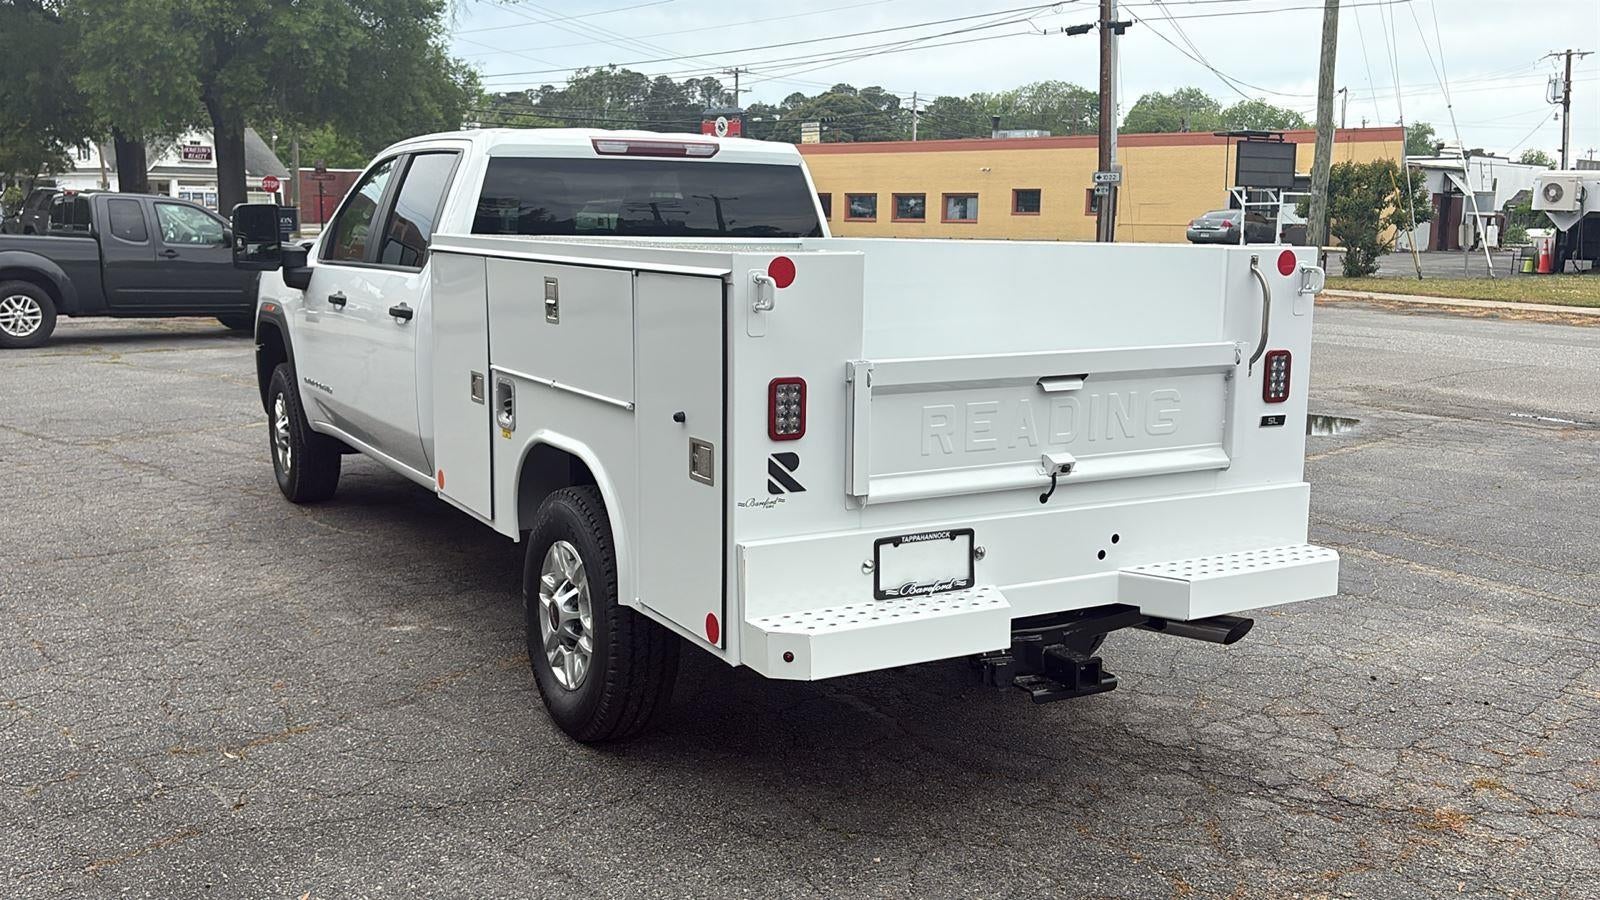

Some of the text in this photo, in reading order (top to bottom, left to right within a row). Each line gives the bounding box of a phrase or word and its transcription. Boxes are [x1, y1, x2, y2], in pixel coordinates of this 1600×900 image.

[263, 180, 279, 189] STOP
[920, 388, 1183, 456] READING
[1267, 417, 1278, 425] SL
[901, 531, 951, 543] TAPPAHANNOCK
[900, 578, 956, 596] Bareford
